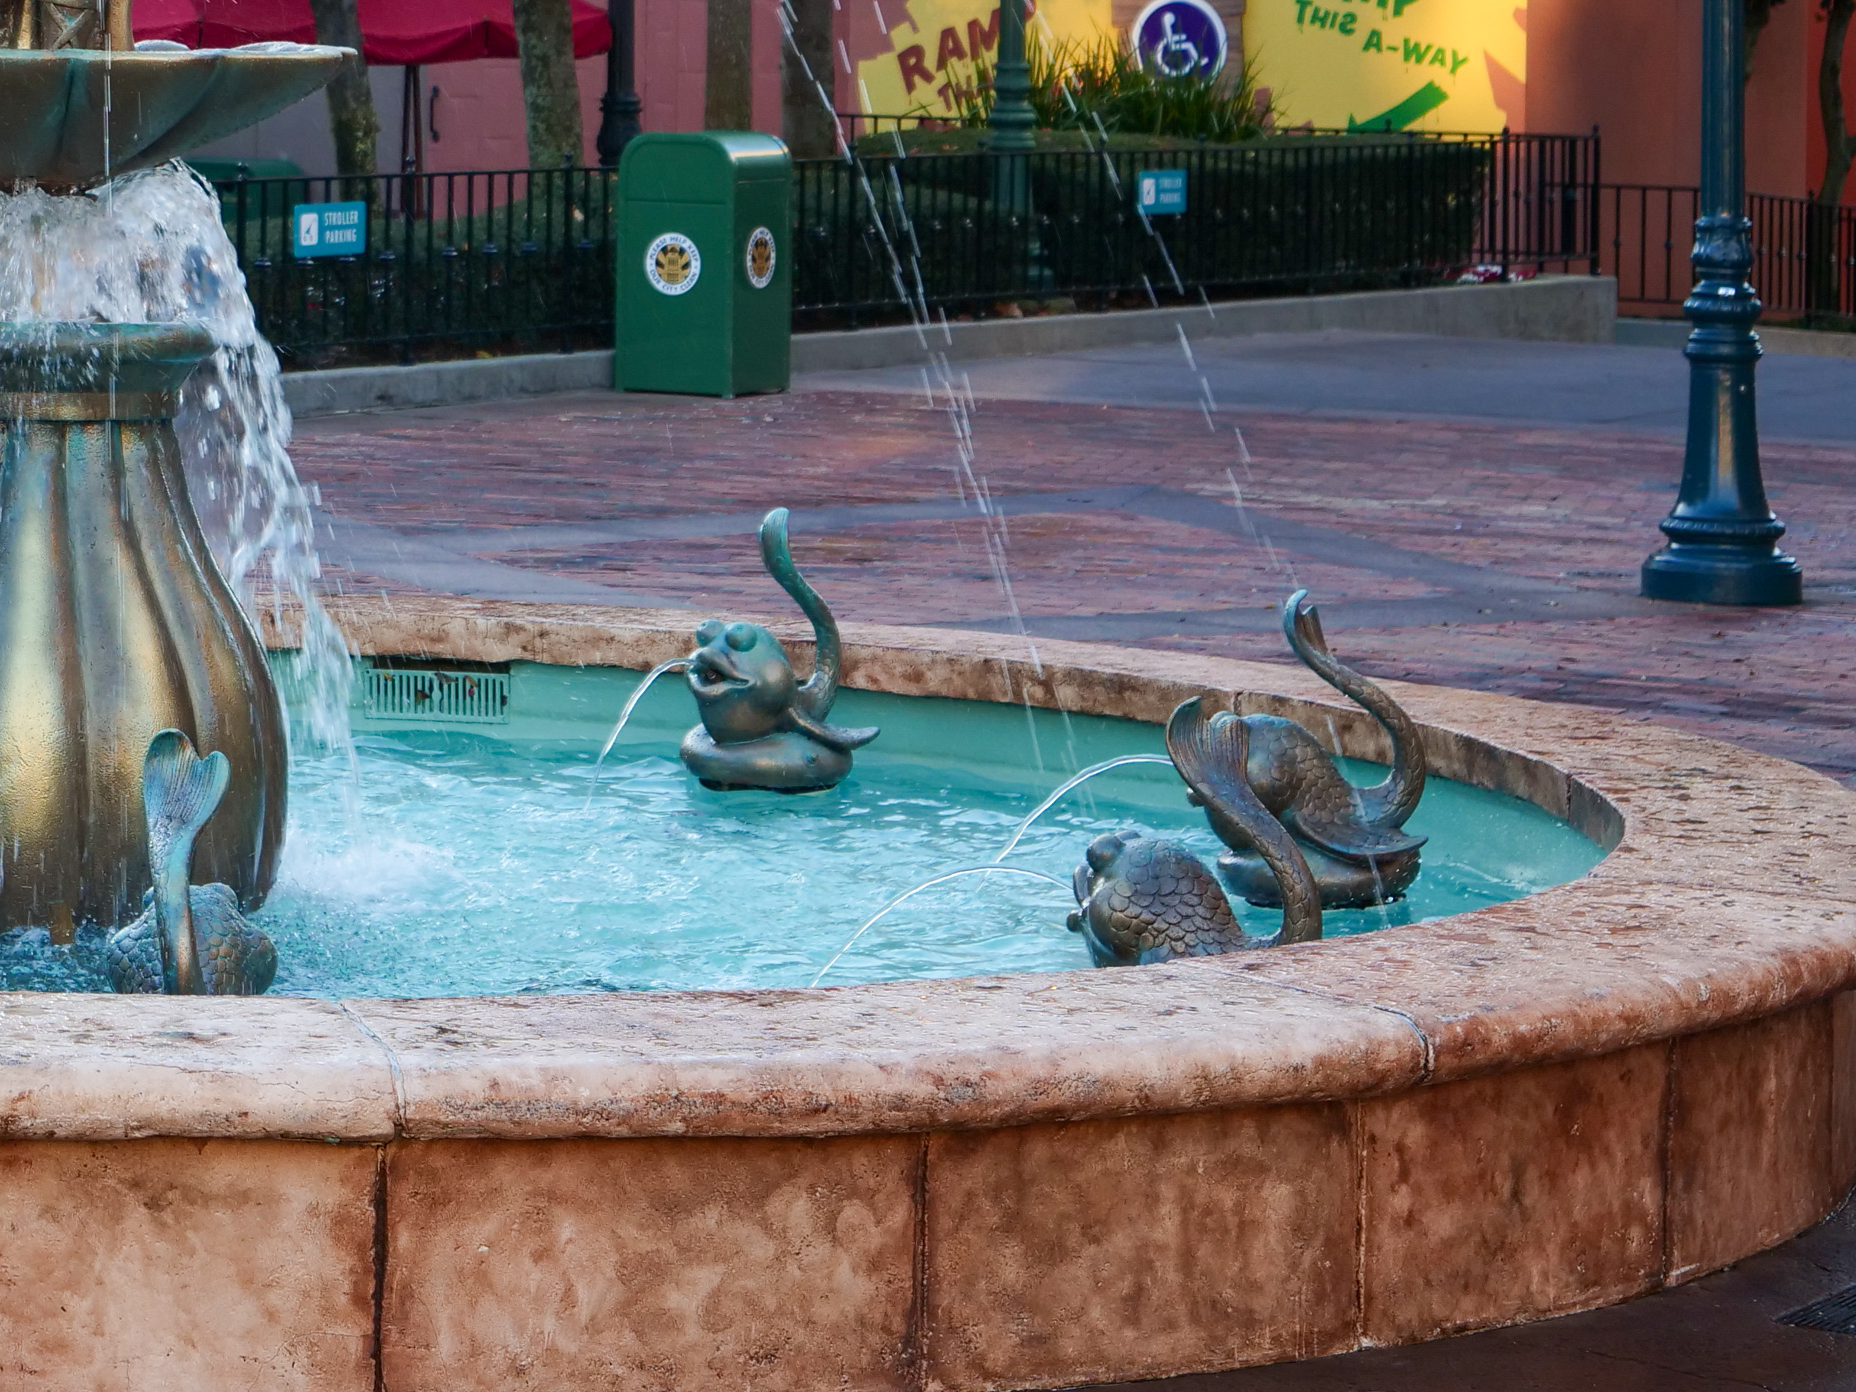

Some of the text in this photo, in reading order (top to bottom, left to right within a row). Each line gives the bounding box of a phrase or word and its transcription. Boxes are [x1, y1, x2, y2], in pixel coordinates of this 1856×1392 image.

[1362, 28, 1469, 76] A-WAY
[324, 210, 358, 226] STROLLER
[326, 229, 357, 244] PARKING
